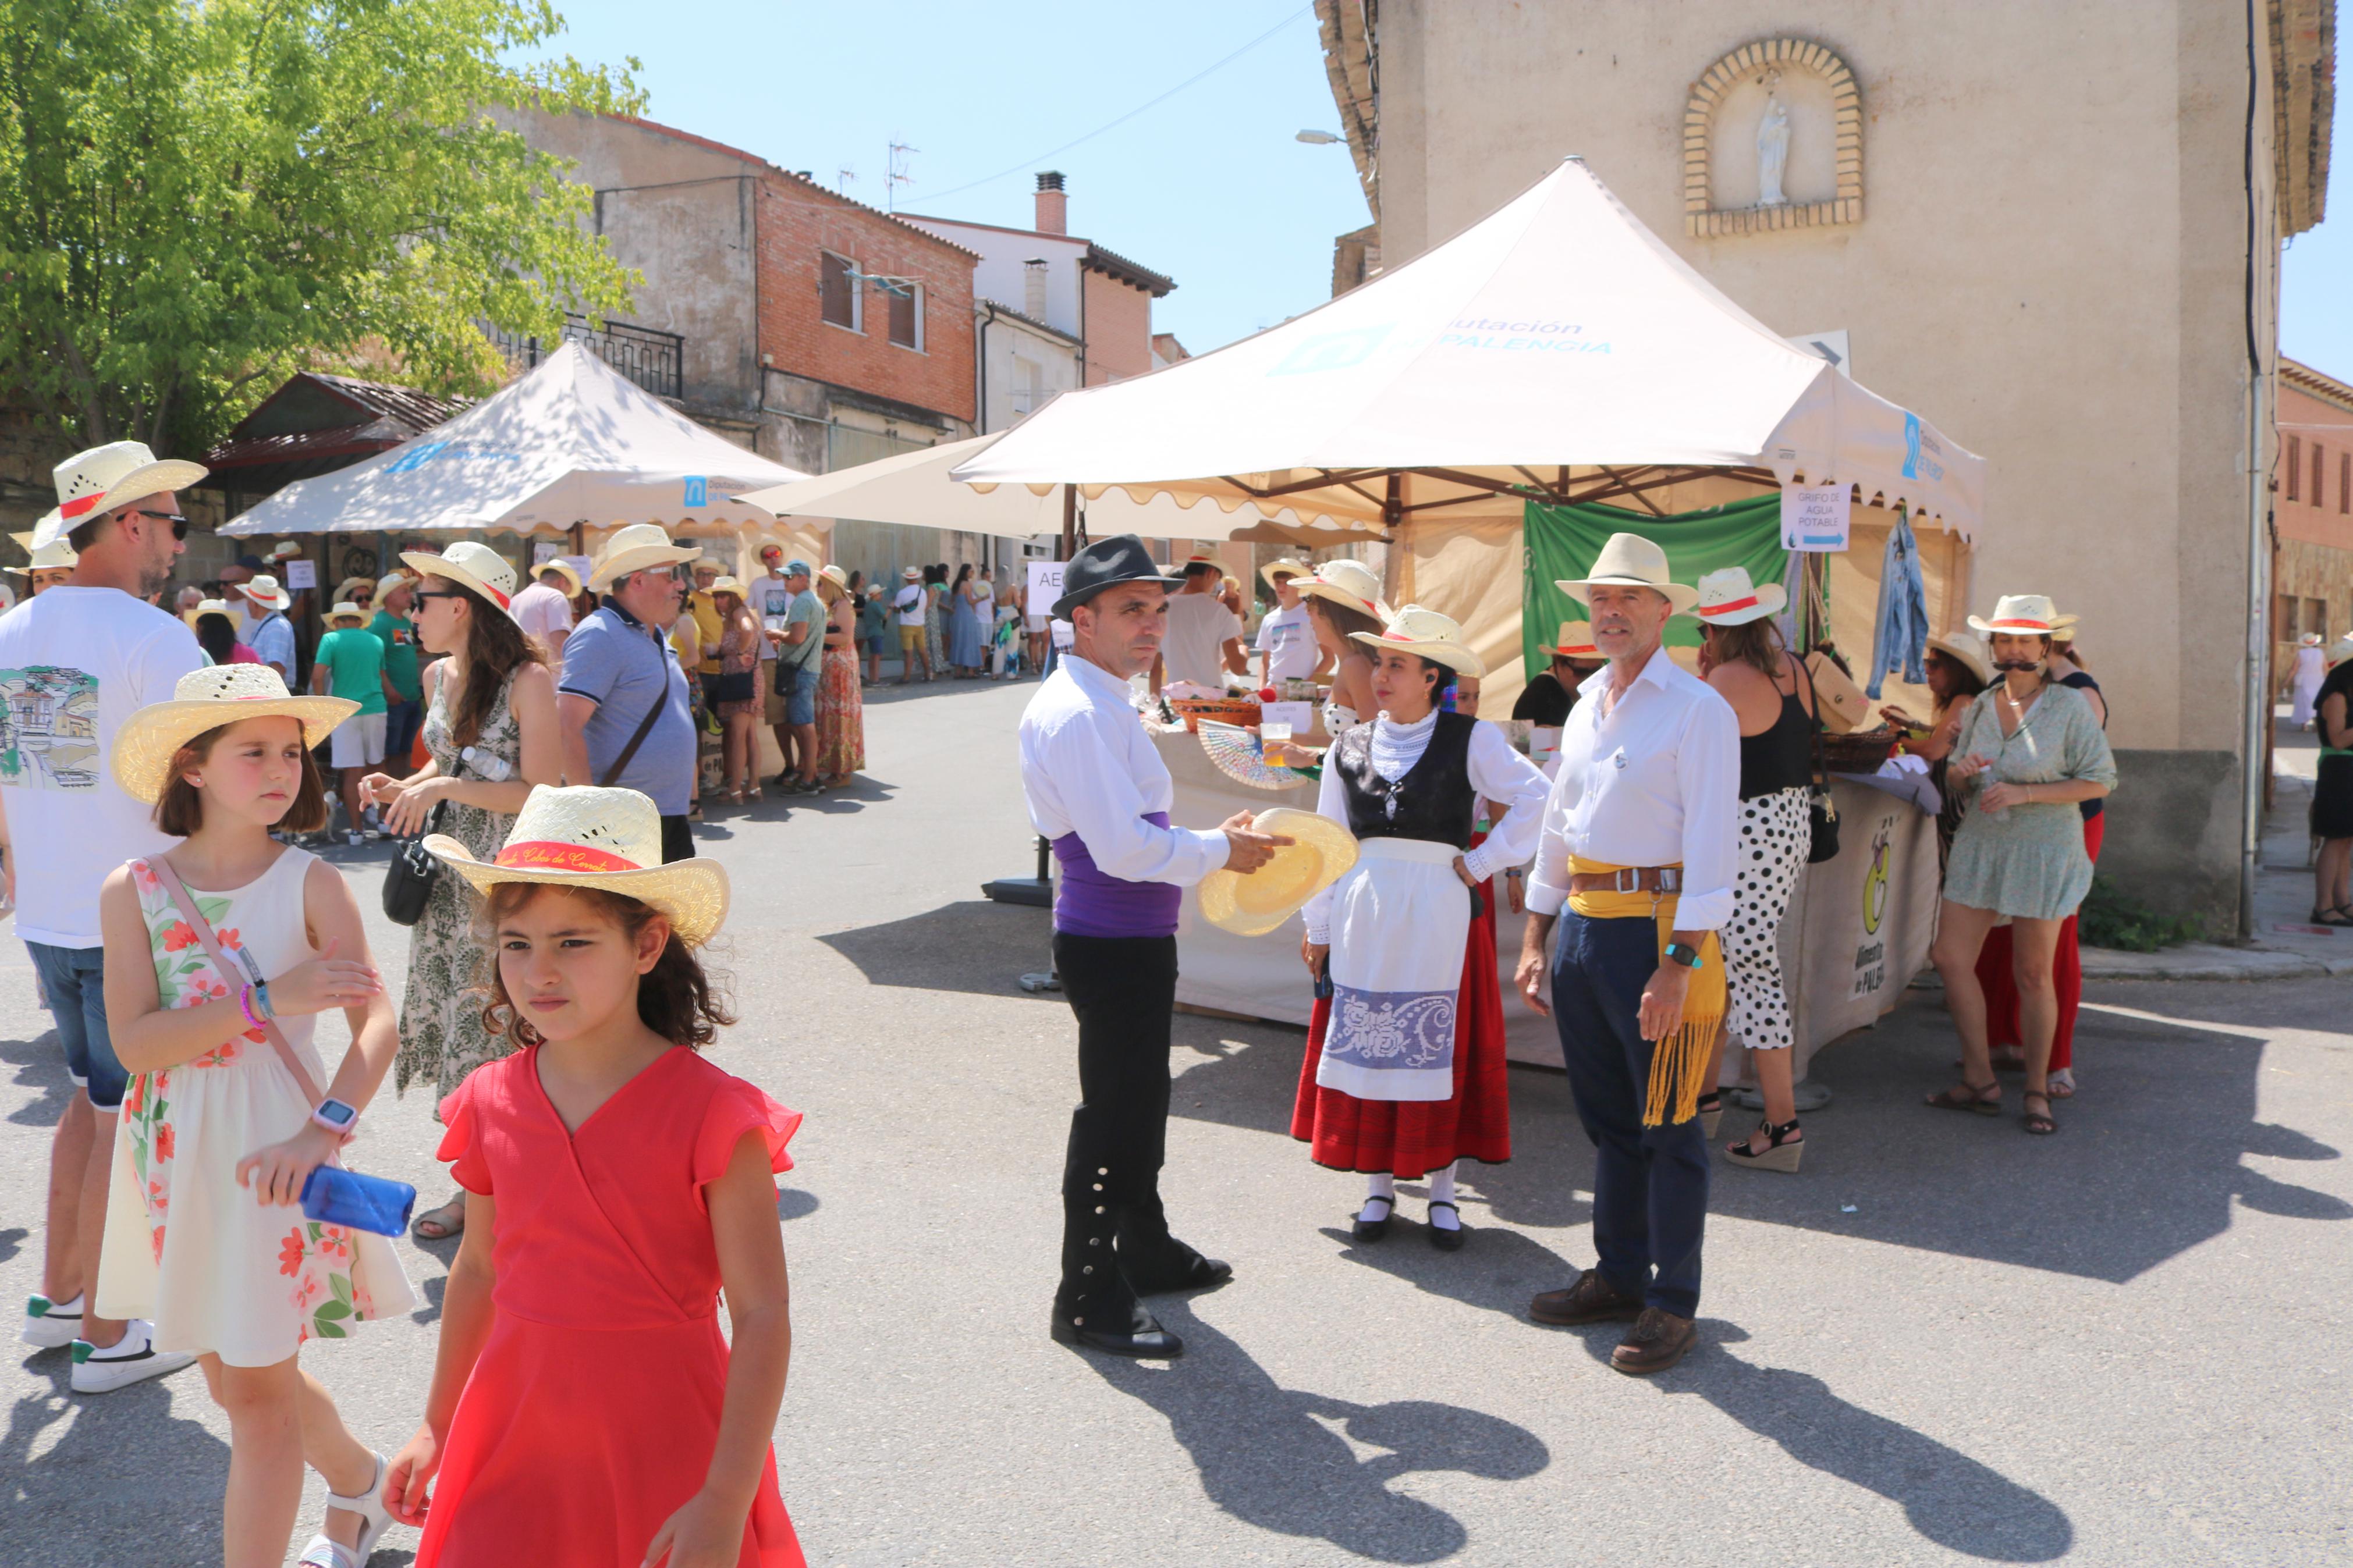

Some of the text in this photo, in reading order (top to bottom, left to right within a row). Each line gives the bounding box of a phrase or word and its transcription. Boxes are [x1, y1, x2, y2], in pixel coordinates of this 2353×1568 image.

[1446, 318, 1583, 335] utación
[1438, 333, 1612, 354] PALENCIA
[709, 479, 746, 490] Diputación
[1798, 492, 1840, 502] GRIFO DE
[1806, 506, 1833, 515] AGUA
[1798, 517, 1839, 527] POTABLE
[552, 851, 565, 864] de
